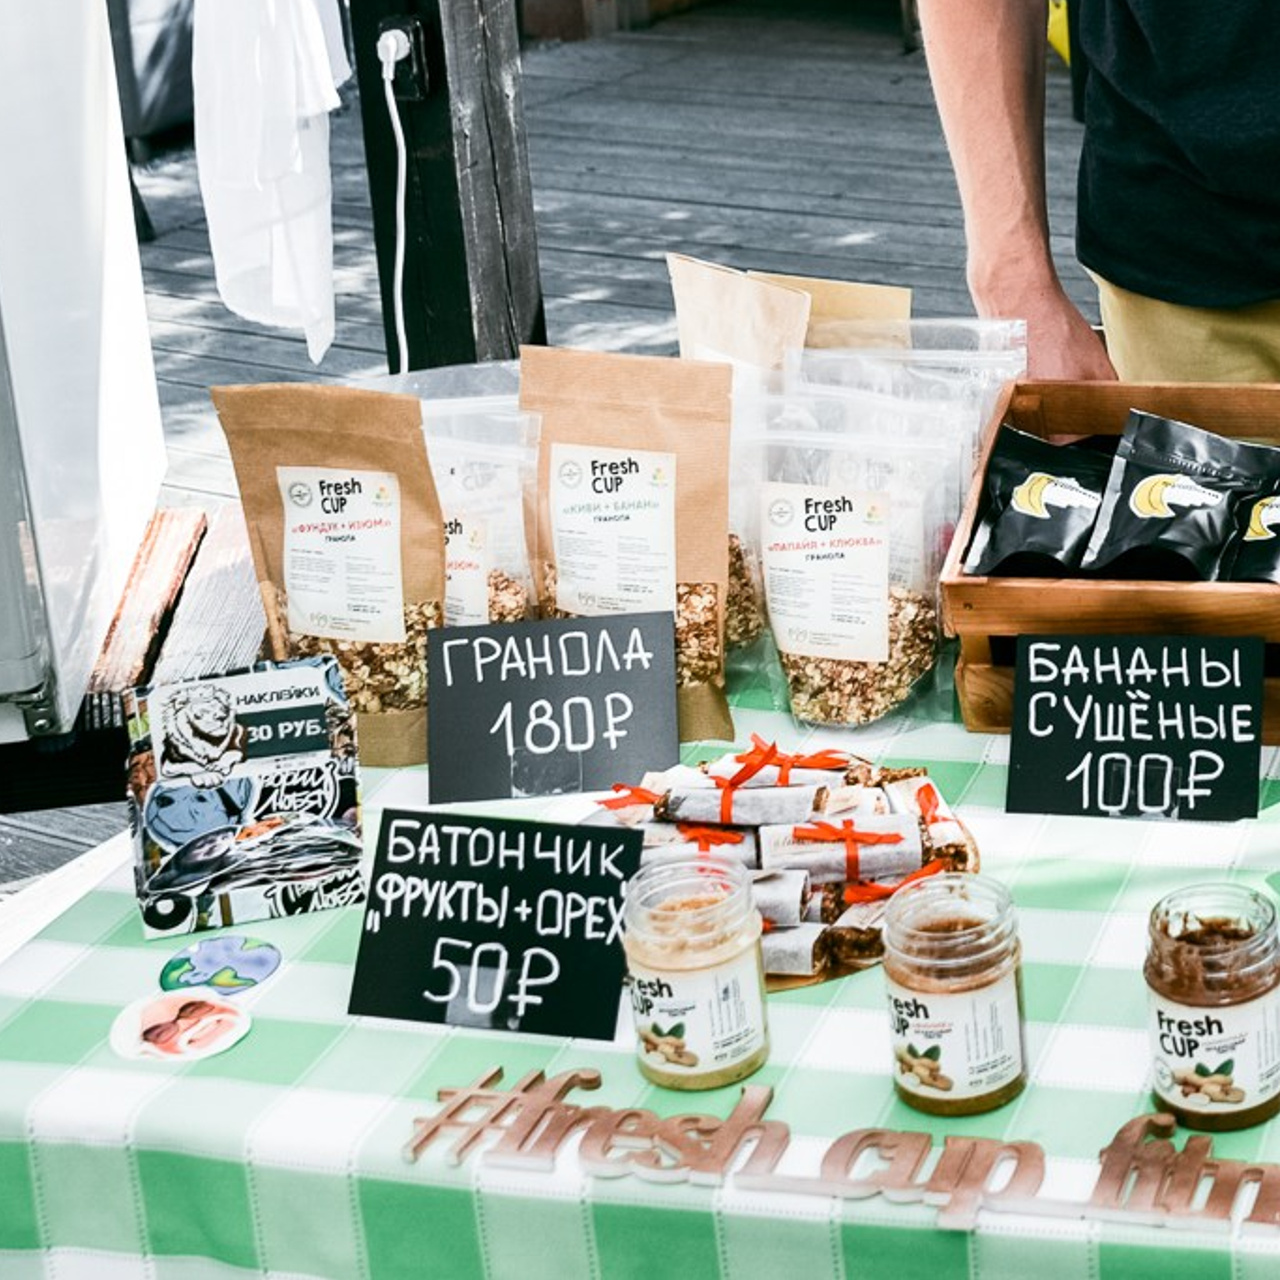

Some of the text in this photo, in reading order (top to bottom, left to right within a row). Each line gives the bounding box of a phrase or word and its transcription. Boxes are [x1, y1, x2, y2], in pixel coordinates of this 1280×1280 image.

[591, 457, 639, 476] Fresh
[319, 478, 362, 496] Fresh
[592, 477, 623, 493] CUP
[321, 497, 347, 514] CUP
[804, 496, 853, 514] Fresh
[805, 515, 837, 532] CUP
[442, 627, 654, 687] ГРАНОЛА
[1029, 642, 1241, 688] БАНАНЫ
[236, 685, 320, 705] НАКЛЕЙКИ
[1028, 690, 1255, 743] СУШЁНЫЕ
[247, 719, 327, 743] 30 РУБ.
[387, 819, 624, 879] БАТОНЧИК
[1157, 1009, 1224, 1037] Fresh
[1160, 1033, 1199, 1058] CUP
[401, 1066, 793, 1186] #fresh
[820, 1127, 1046, 1232] cup
